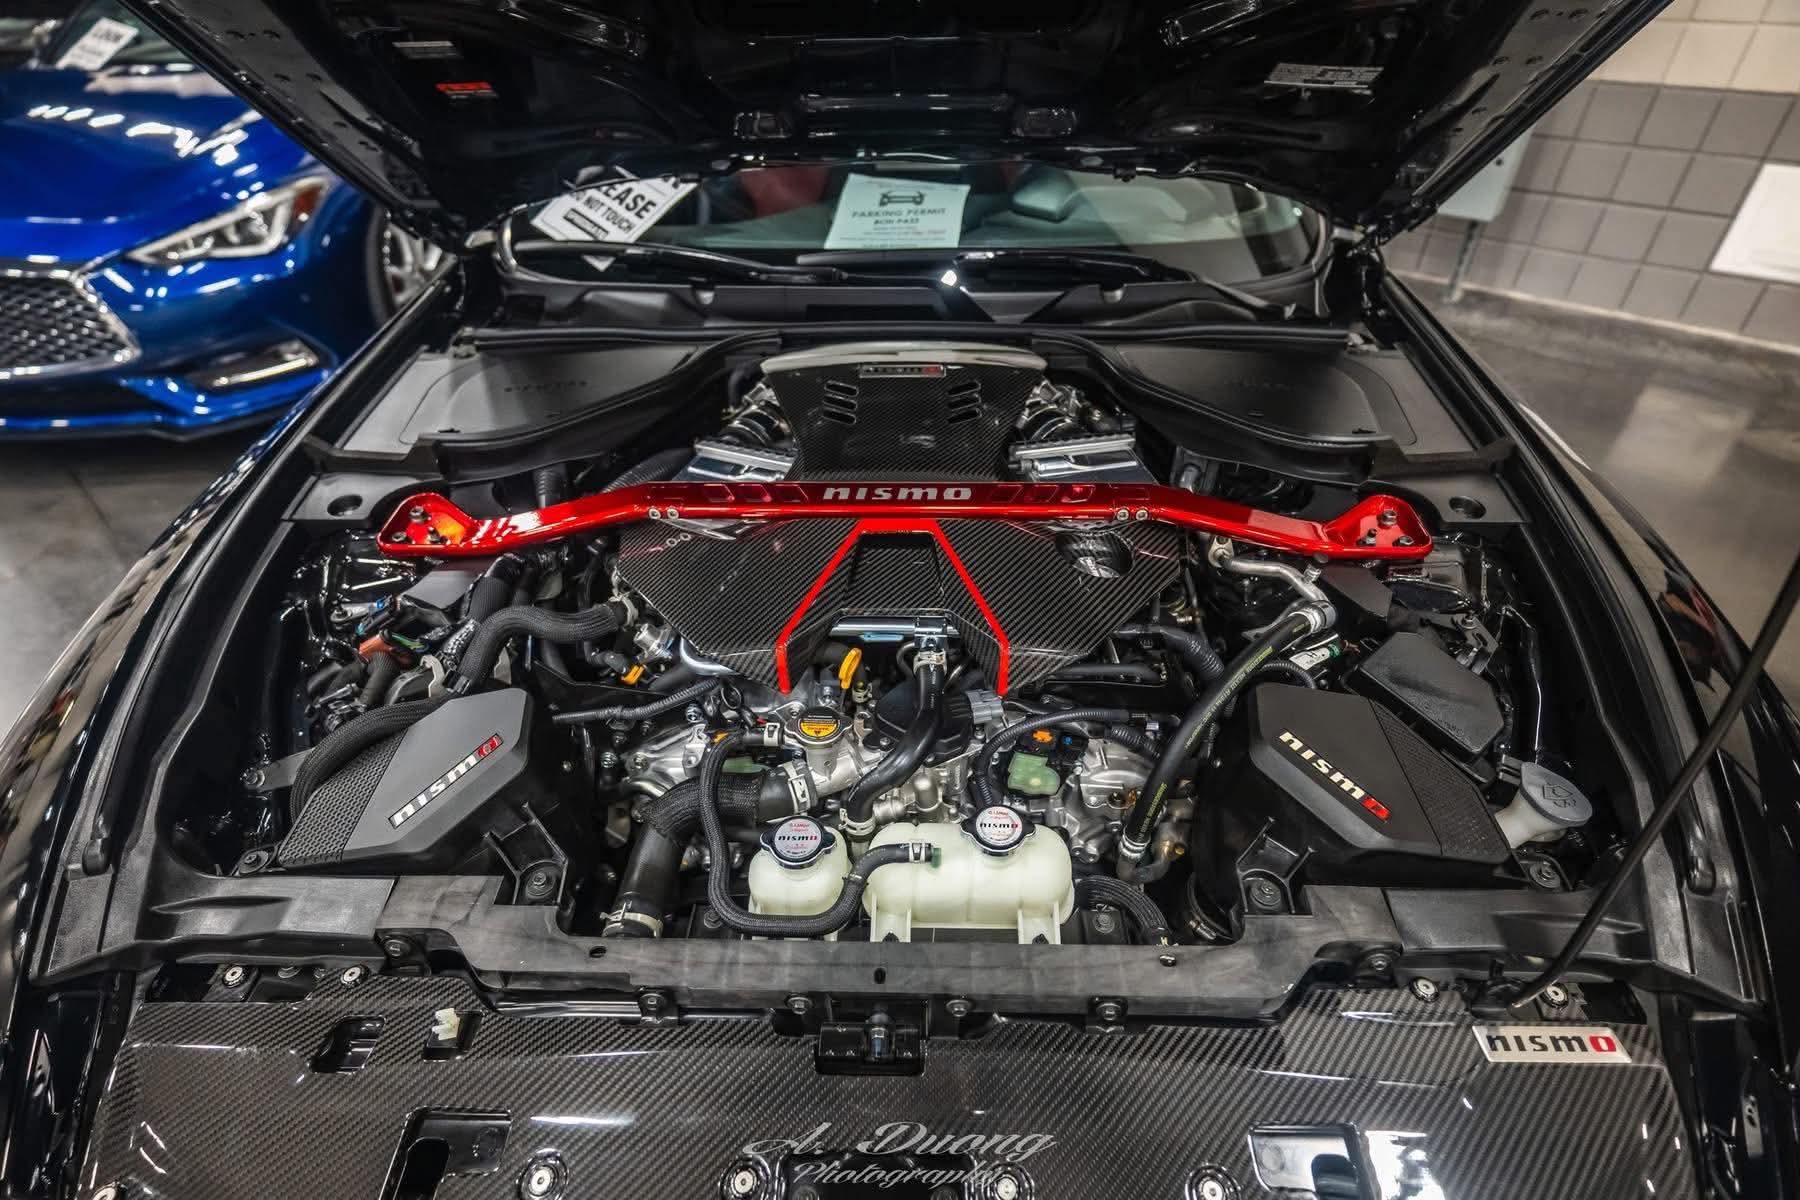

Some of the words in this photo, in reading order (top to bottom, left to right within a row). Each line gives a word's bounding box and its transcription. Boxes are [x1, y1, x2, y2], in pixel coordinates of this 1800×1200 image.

[583, 194, 605, 213] NOT
[601, 204, 637, 234] TOUCH
[852, 209, 903, 218] PARKING
[906, 207, 946, 216] PERMIT
[822, 487, 972, 500] nismo
[393, 735, 501, 826] nismo
[1279, 732, 1390, 820] nismo
[1486, 1035, 1617, 1053] nismo
